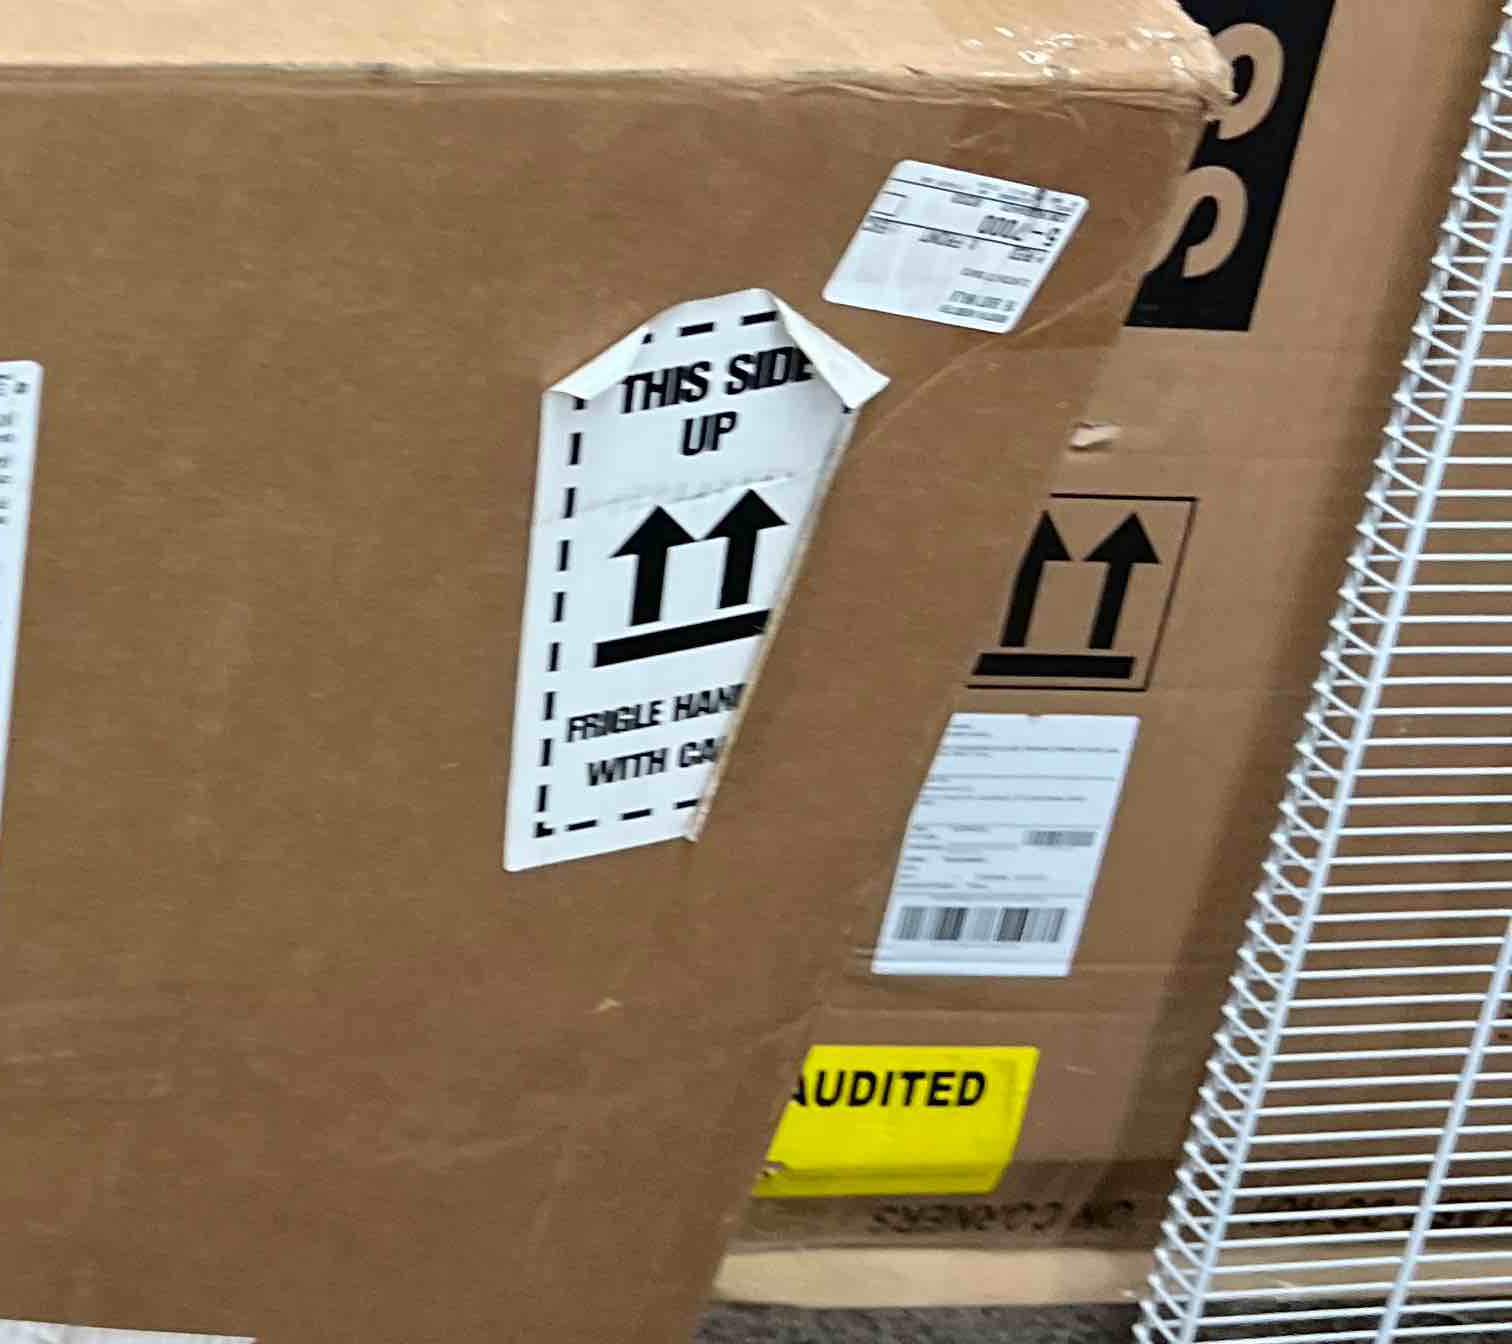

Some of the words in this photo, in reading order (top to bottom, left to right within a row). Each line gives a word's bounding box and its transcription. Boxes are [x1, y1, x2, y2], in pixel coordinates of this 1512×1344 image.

[619, 360, 711, 414] THIS
[680, 410, 738, 456] UP
[586, 747, 669, 787] WITH
